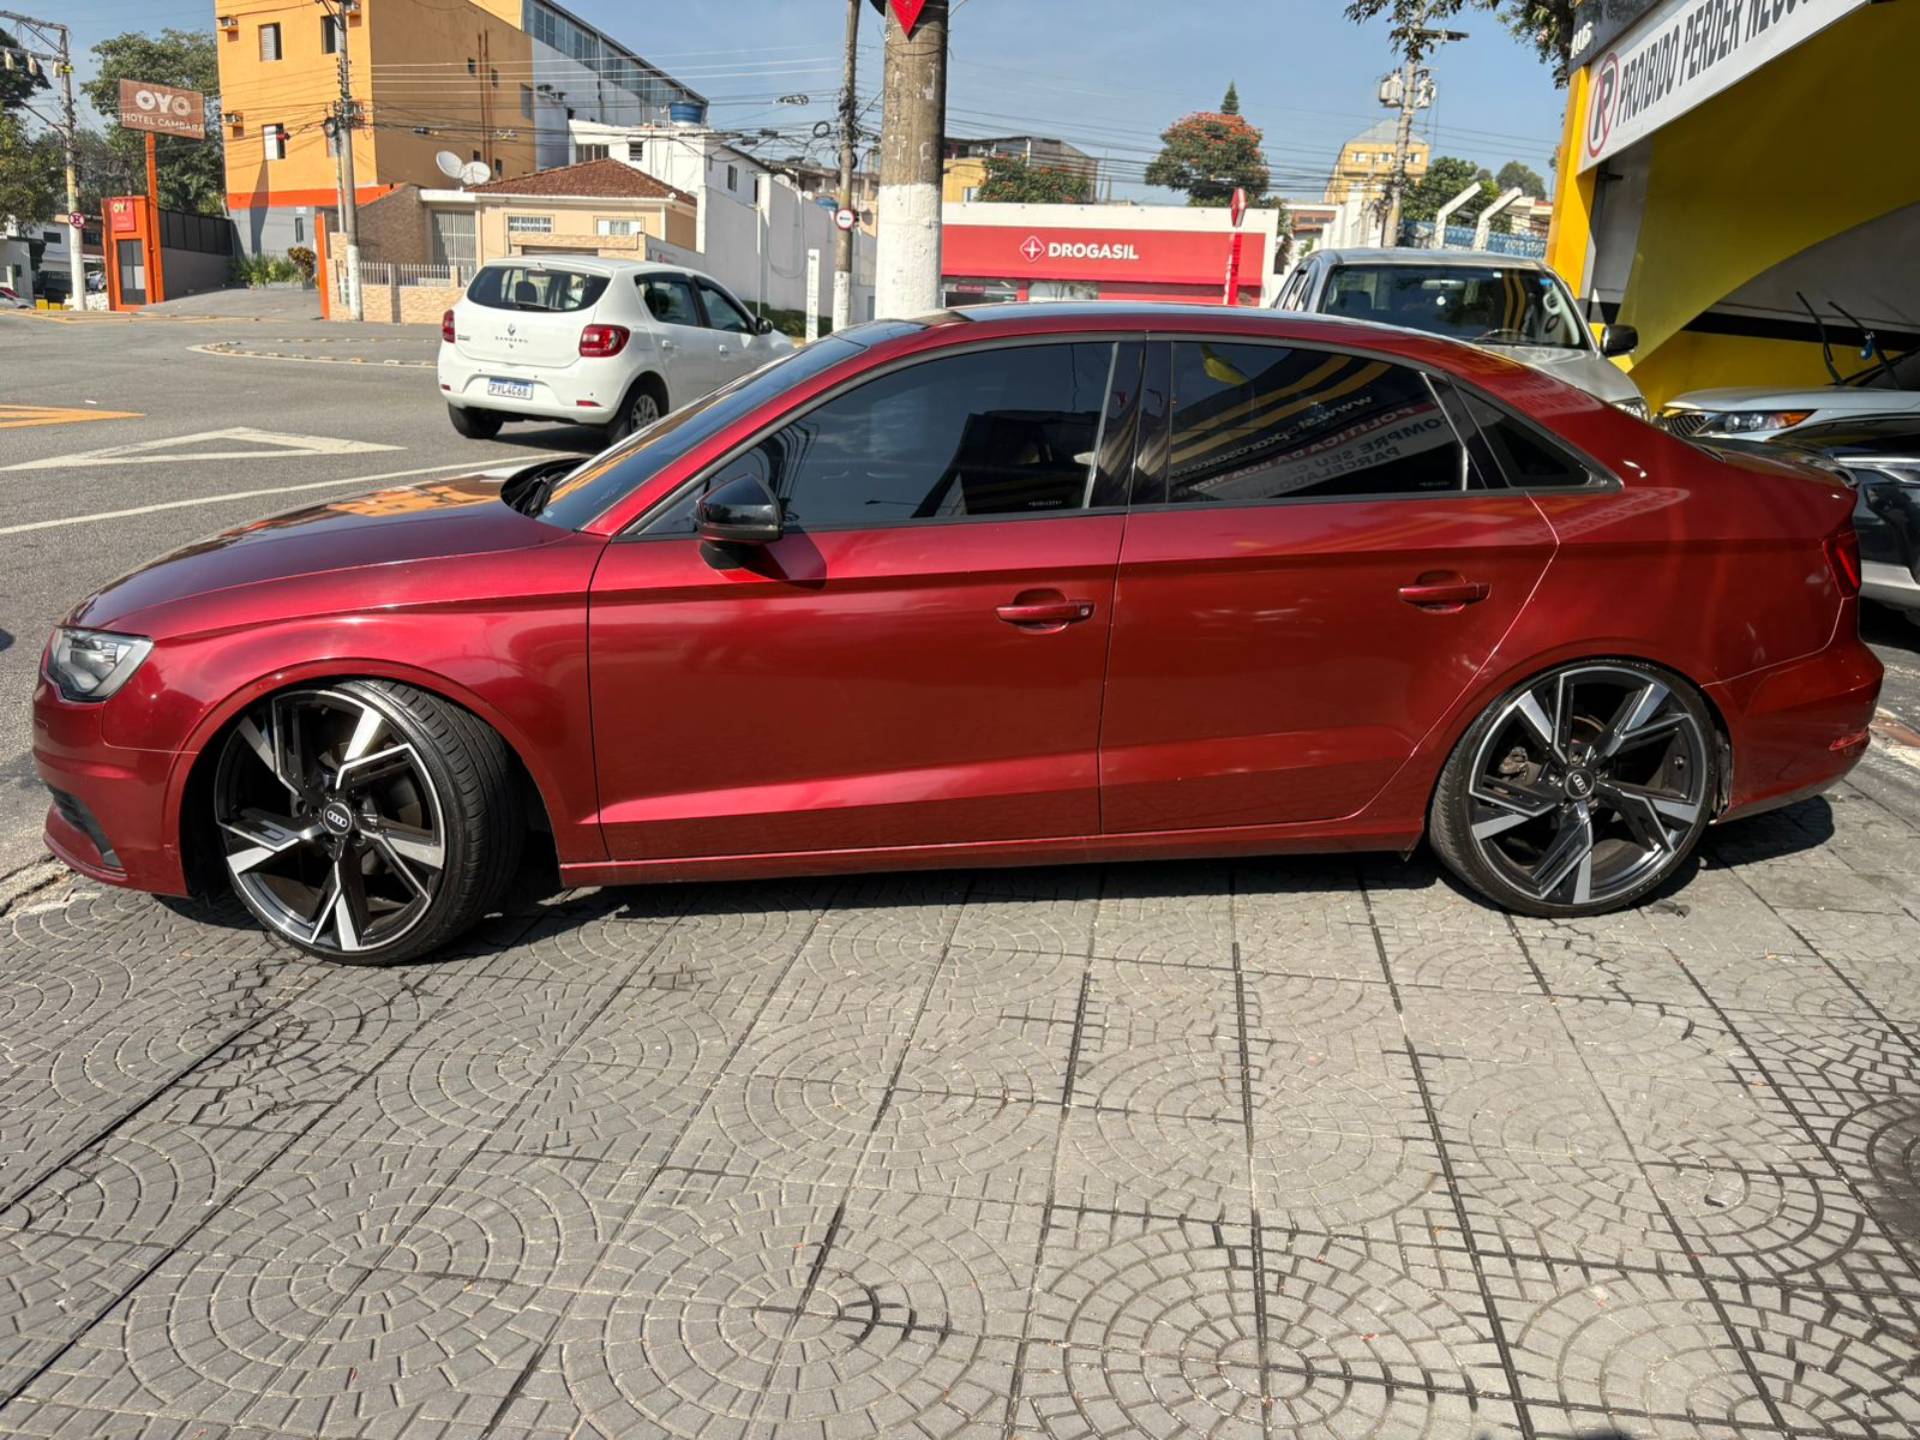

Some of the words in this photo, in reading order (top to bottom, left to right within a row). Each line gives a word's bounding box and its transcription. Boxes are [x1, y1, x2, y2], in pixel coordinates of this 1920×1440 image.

[1615, 24, 1679, 128] PROIBIDO
[1679, 0, 1744, 87] PERDER
[135, 89, 192, 116] OYO
[121, 111, 156, 126] HOTEL
[1048, 242, 1139, 260] DROGASIL
